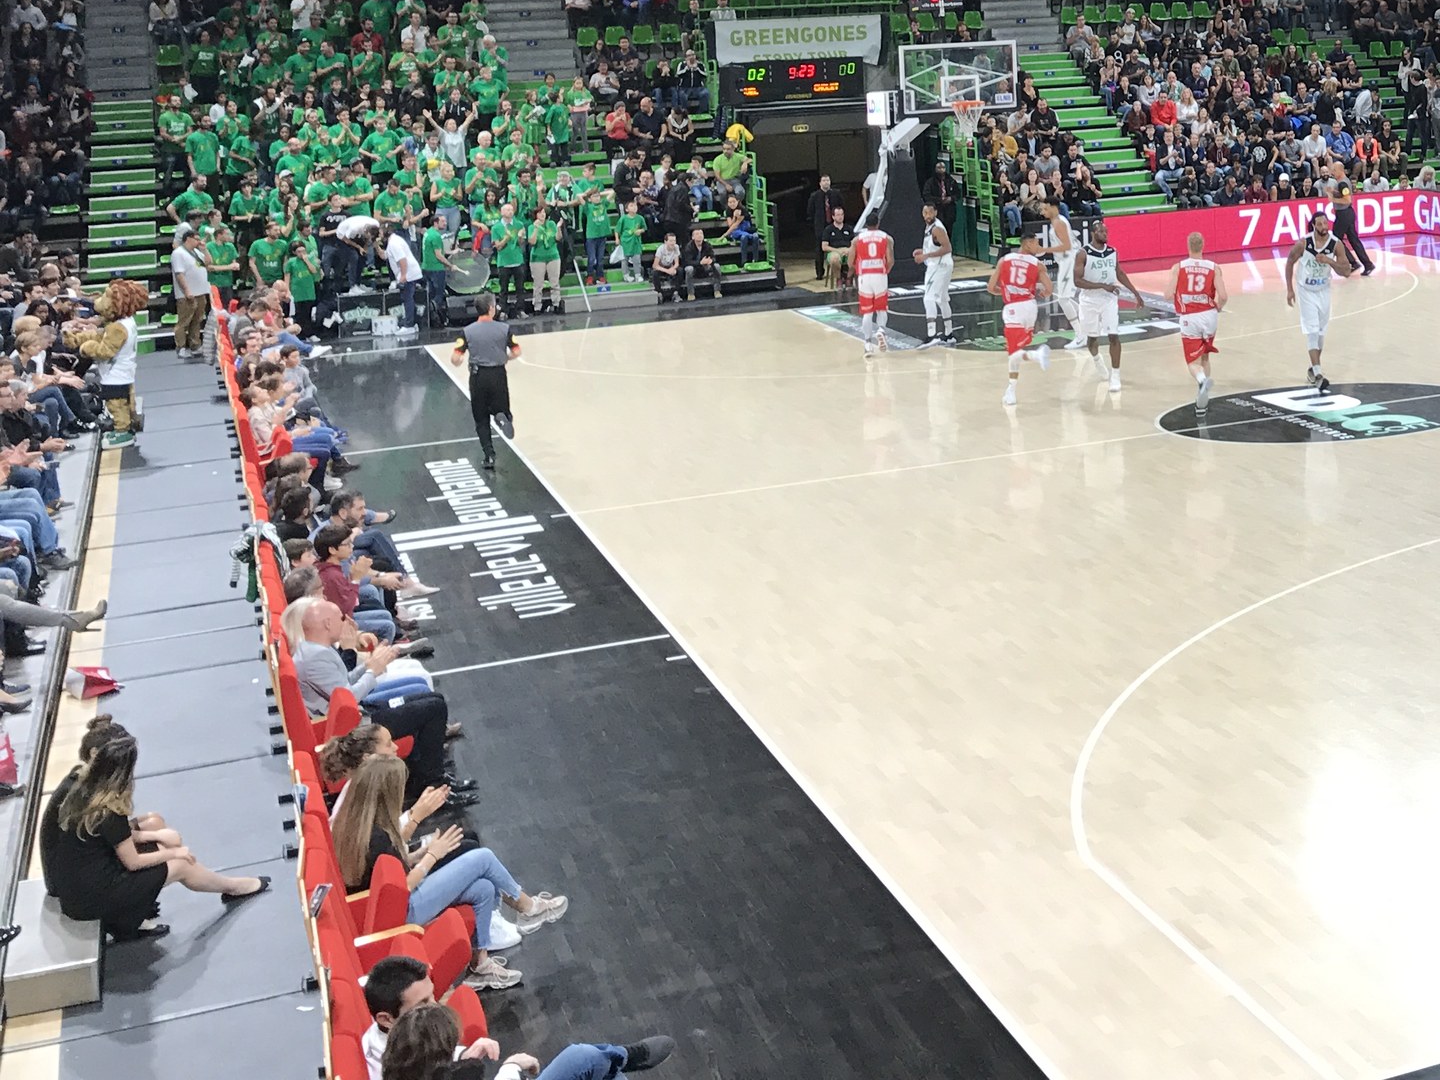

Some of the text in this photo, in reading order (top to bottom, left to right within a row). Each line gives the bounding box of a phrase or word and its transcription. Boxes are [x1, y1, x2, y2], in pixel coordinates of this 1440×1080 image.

[730, 24, 868, 46] GREENGONES
[748, 68, 766, 82] 02
[788, 64, 816, 80] 9:23
[839, 62, 856, 76] 00
[1238, 208, 1262, 247] 7
[1357, 196, 1406, 235] DE
[868, 242, 877, 258] 0
[1010, 266, 1028, 285] 15
[1102, 270, 1108, 280] 5
[1187, 274, 1206, 292] 13
[1305, 278, 1326, 286] LDLC
[391, 458, 544, 558] villeurbanne
[469, 553, 547, 579] de
[477, 575, 577, 619] ville
